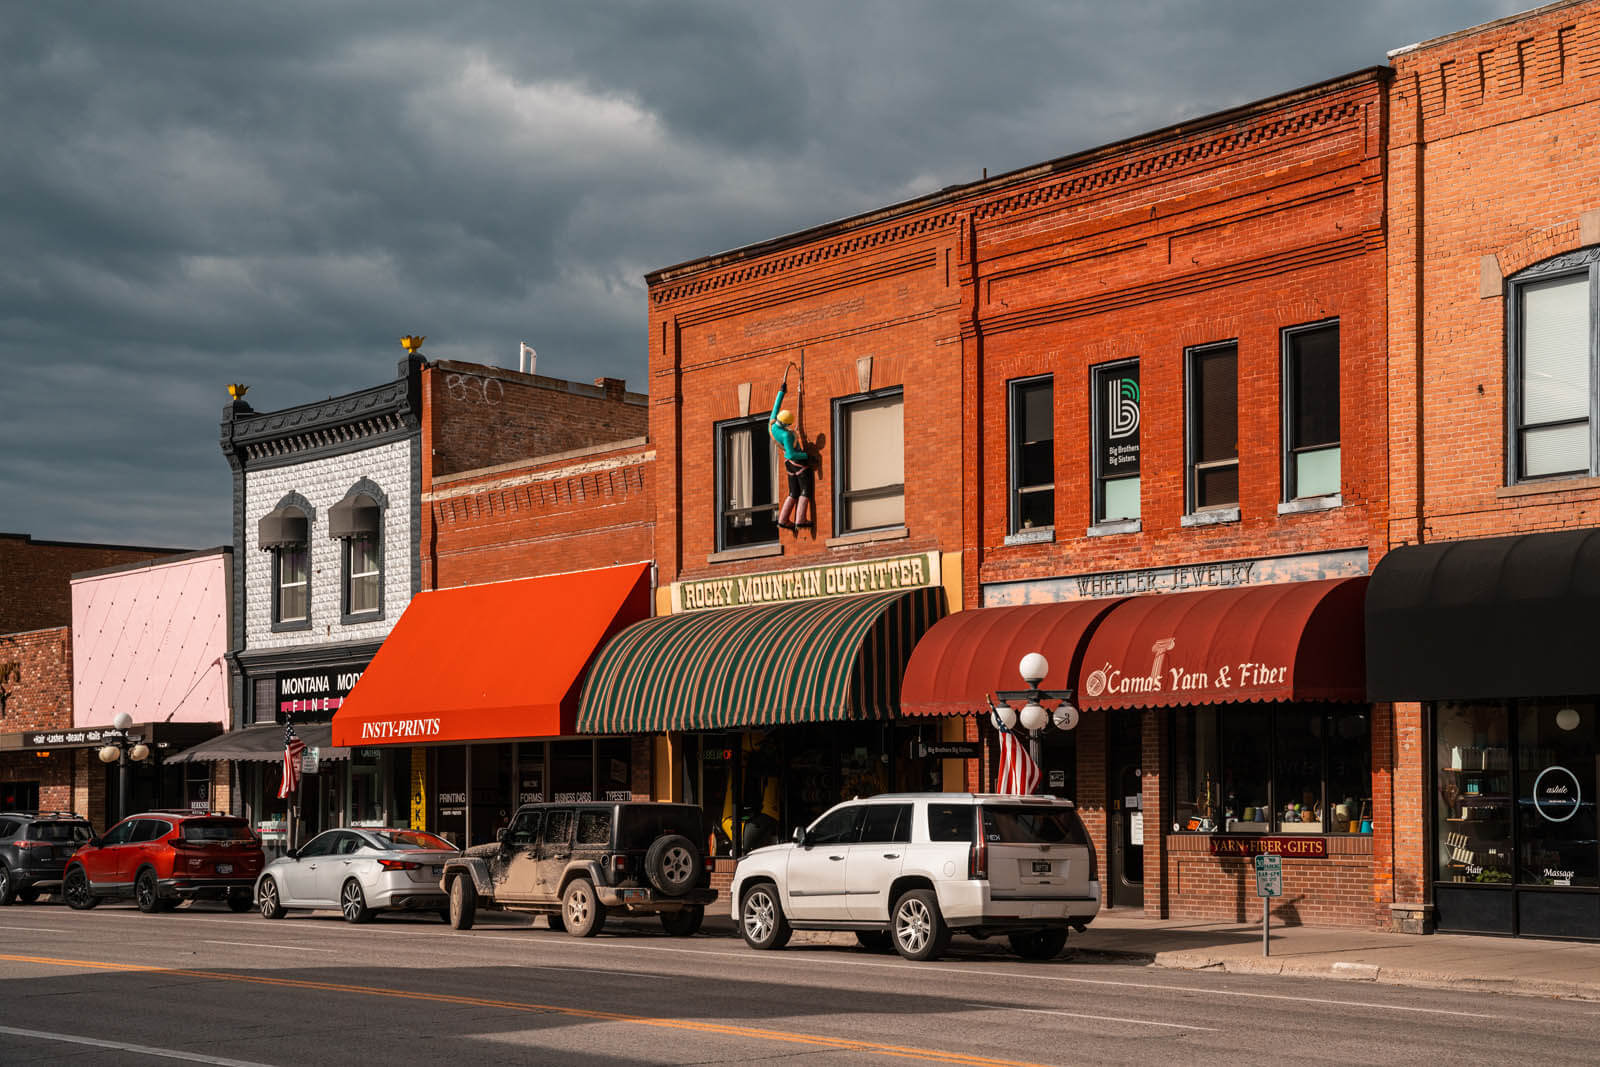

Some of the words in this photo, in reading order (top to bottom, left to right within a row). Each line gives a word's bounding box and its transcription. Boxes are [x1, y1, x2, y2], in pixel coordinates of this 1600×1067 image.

[1109, 446, 1118, 456] Big
[1118, 444, 1139, 454] Brothers
[1109, 456, 1118, 466] Big
[684, 581, 734, 609] ROCKY
[738, 570, 822, 603] MOUNTAIN
[826, 557, 926, 594] OUTFITTER
[1077, 571, 1157, 597] WHEELER
[1170, 563, 1255, 590] JEWELRY
[282, 676, 330, 695] MONTANA
[337, 672, 364, 691] MOD
[1107, 669, 1164, 694] Camas
[1169, 667, 1208, 691] Yarn
[1215, 665, 1232, 689] &
[1238, 663, 1288, 688] Fiber
[292, 697, 329, 713] FINE
[361, 718, 441, 739] INSTY-PRINTS
[1546, 784, 1568, 794] astute
[439, 793, 466, 803] PRINTING
[520, 792, 543, 803] FORMS
[1213, 839, 1245, 852] YARN
[1250, 840, 1282, 852] FIBER
[1287, 840, 1323, 853] GIFTS
[1465, 864, 1483, 875] Hair
[1544, 868, 1575, 881] Massage
